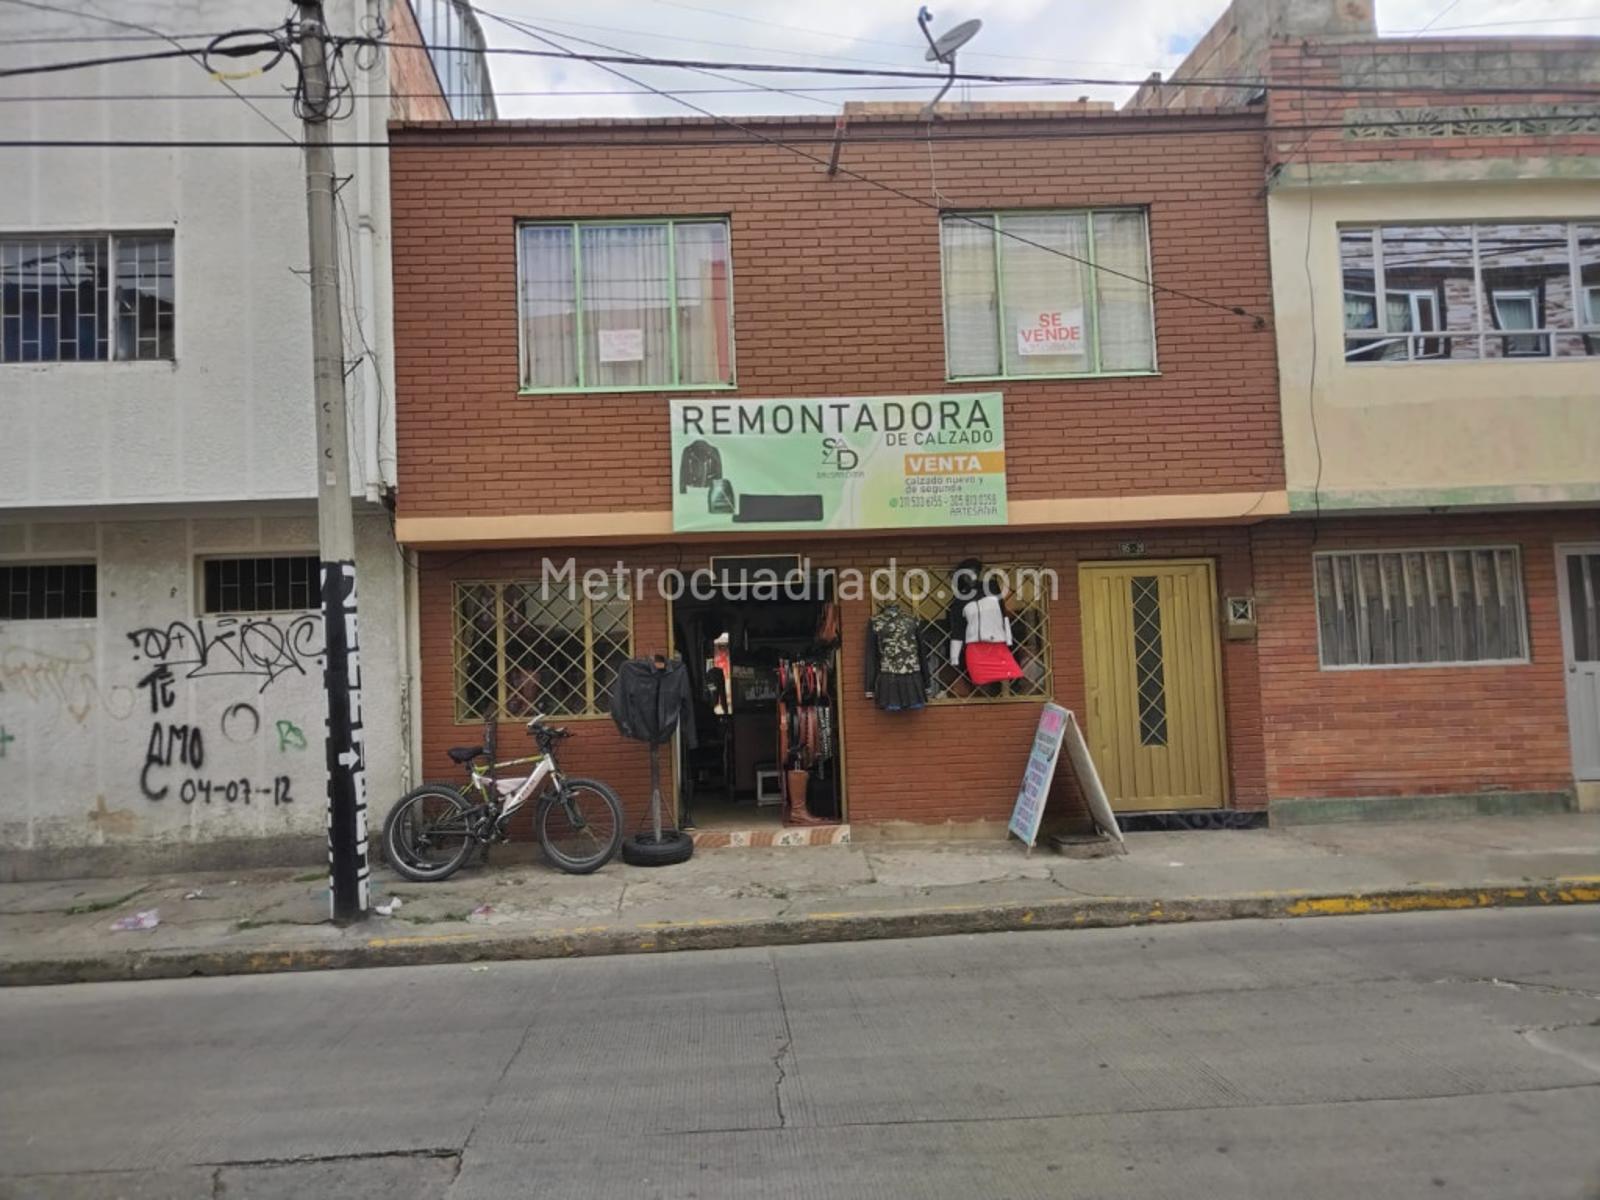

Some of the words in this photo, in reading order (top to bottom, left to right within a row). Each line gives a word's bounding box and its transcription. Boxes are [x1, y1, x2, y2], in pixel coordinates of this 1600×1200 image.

[1039, 312, 1062, 327] SE
[1021, 326, 1081, 342] VENDE
[682, 400, 990, 435] REMONTADORA
[886, 432, 908, 446] DE
[913, 430, 993, 445] CALZADO
[909, 456, 982, 472] VENTA
[146, 722, 204, 770] AMO
